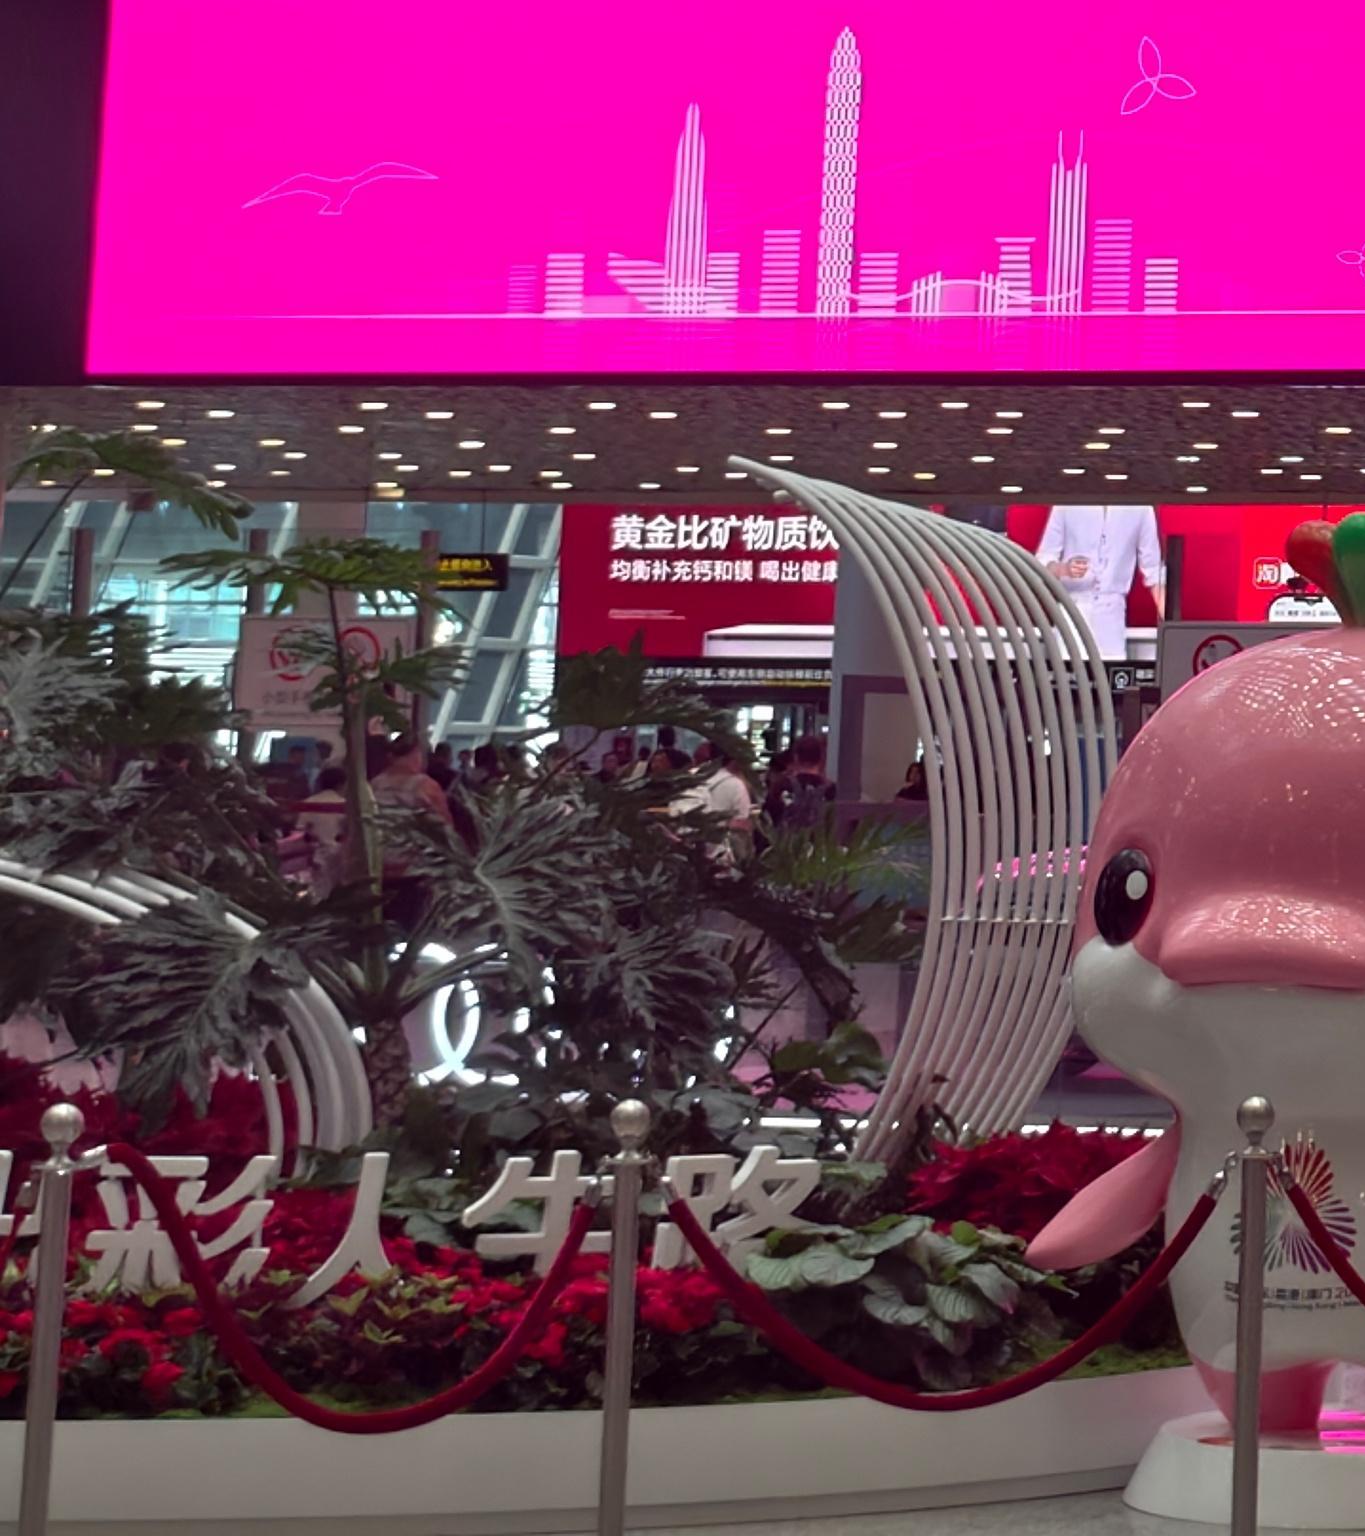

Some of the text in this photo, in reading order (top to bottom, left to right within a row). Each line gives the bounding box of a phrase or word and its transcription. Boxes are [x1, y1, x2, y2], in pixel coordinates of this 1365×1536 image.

[609, 558, 754, 583] 均衡补充钙和镁
